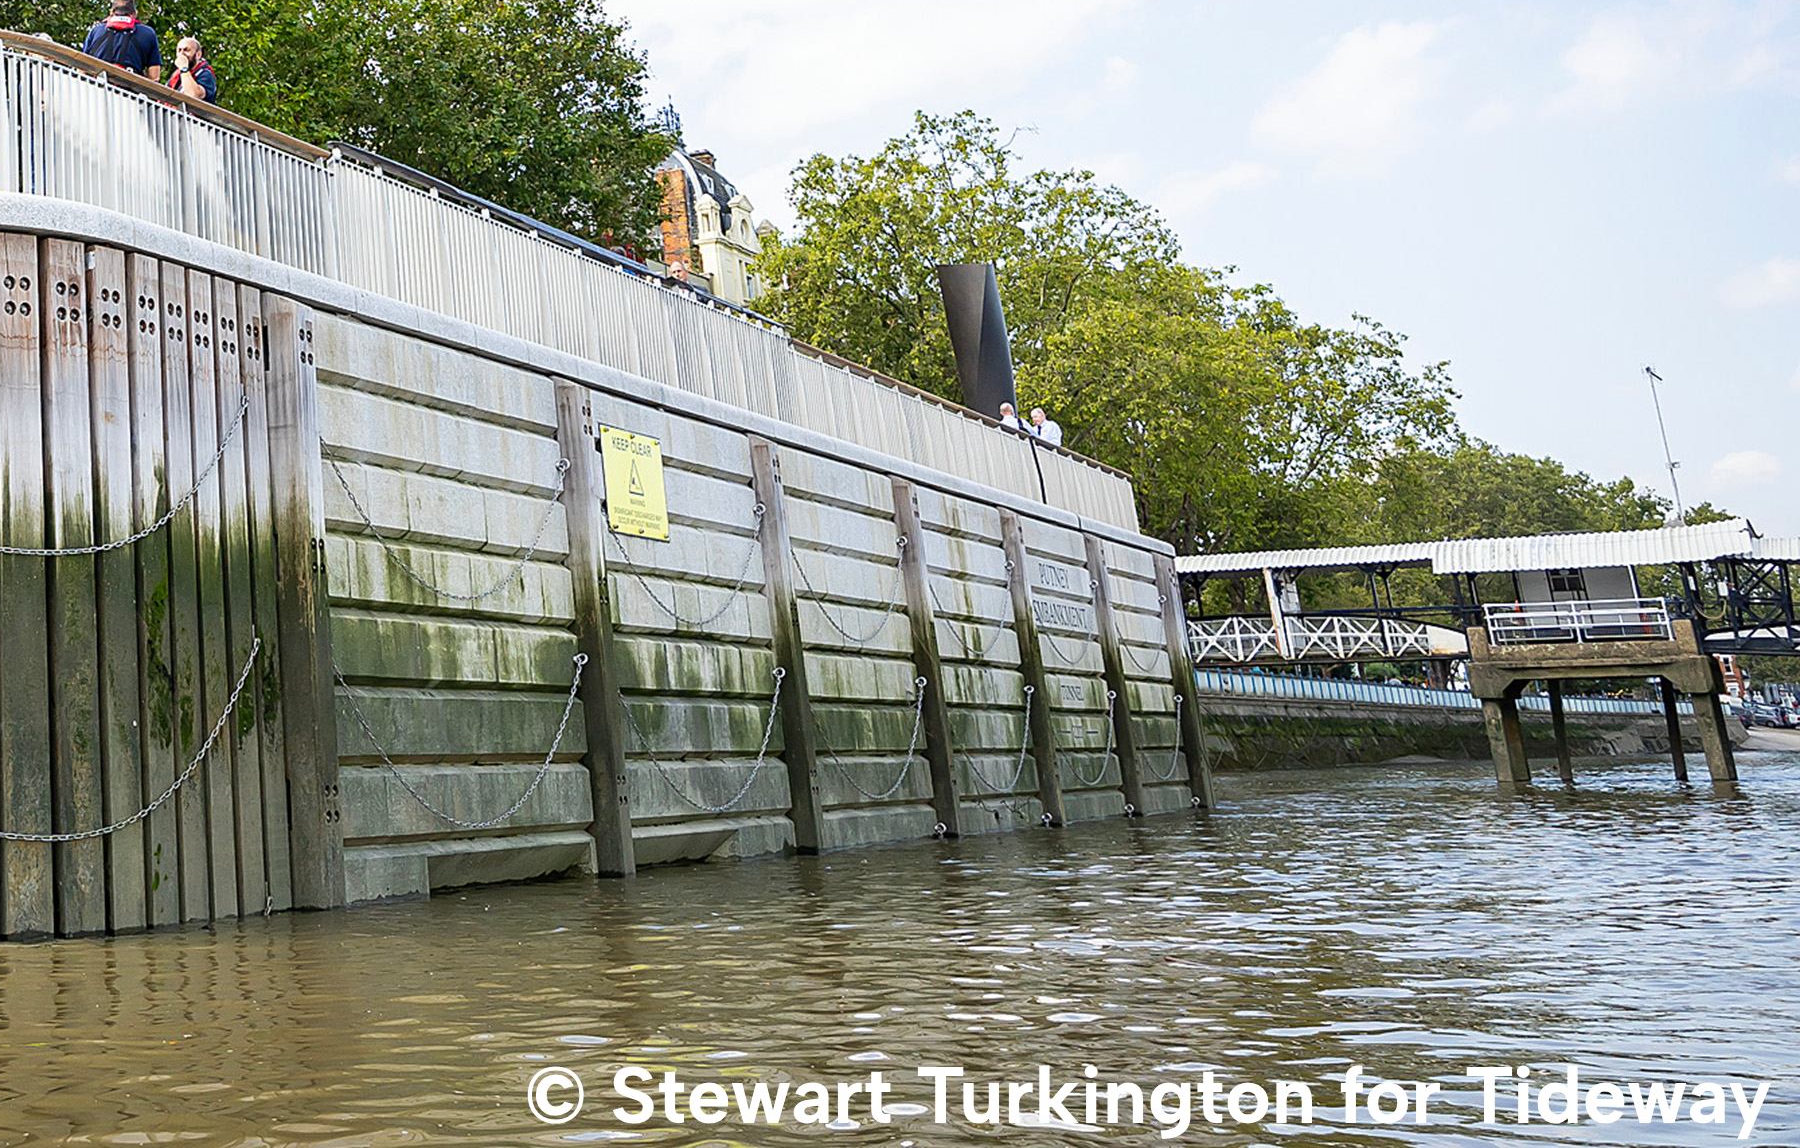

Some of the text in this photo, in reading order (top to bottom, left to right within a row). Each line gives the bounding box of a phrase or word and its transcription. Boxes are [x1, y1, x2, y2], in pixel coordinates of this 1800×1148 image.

[611, 436, 652, 458] KEEP CLEAR
[1038, 562, 1069, 589] PUTNEY
[1032, 599, 1087, 629] EMBANKMENT
